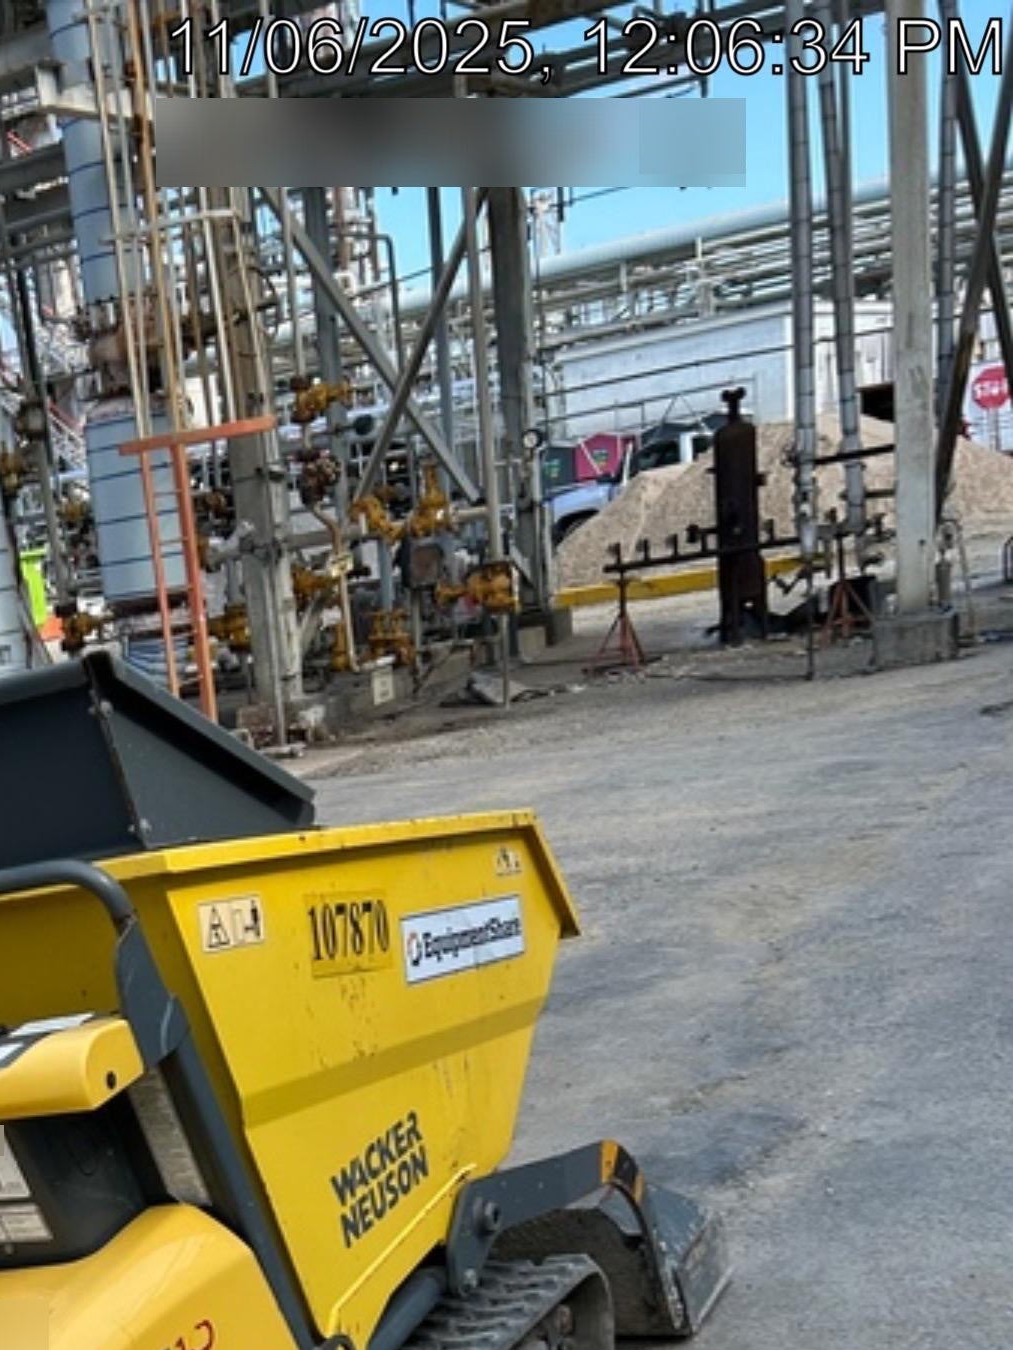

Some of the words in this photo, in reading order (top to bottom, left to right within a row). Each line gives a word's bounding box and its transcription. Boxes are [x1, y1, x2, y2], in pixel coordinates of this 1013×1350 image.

[308, 900, 389, 960] 107870
[423, 917, 521, 962] EquipmentShare
[331, 1110, 423, 1207] WACKER
[340, 1144, 429, 1249] NEUSON
